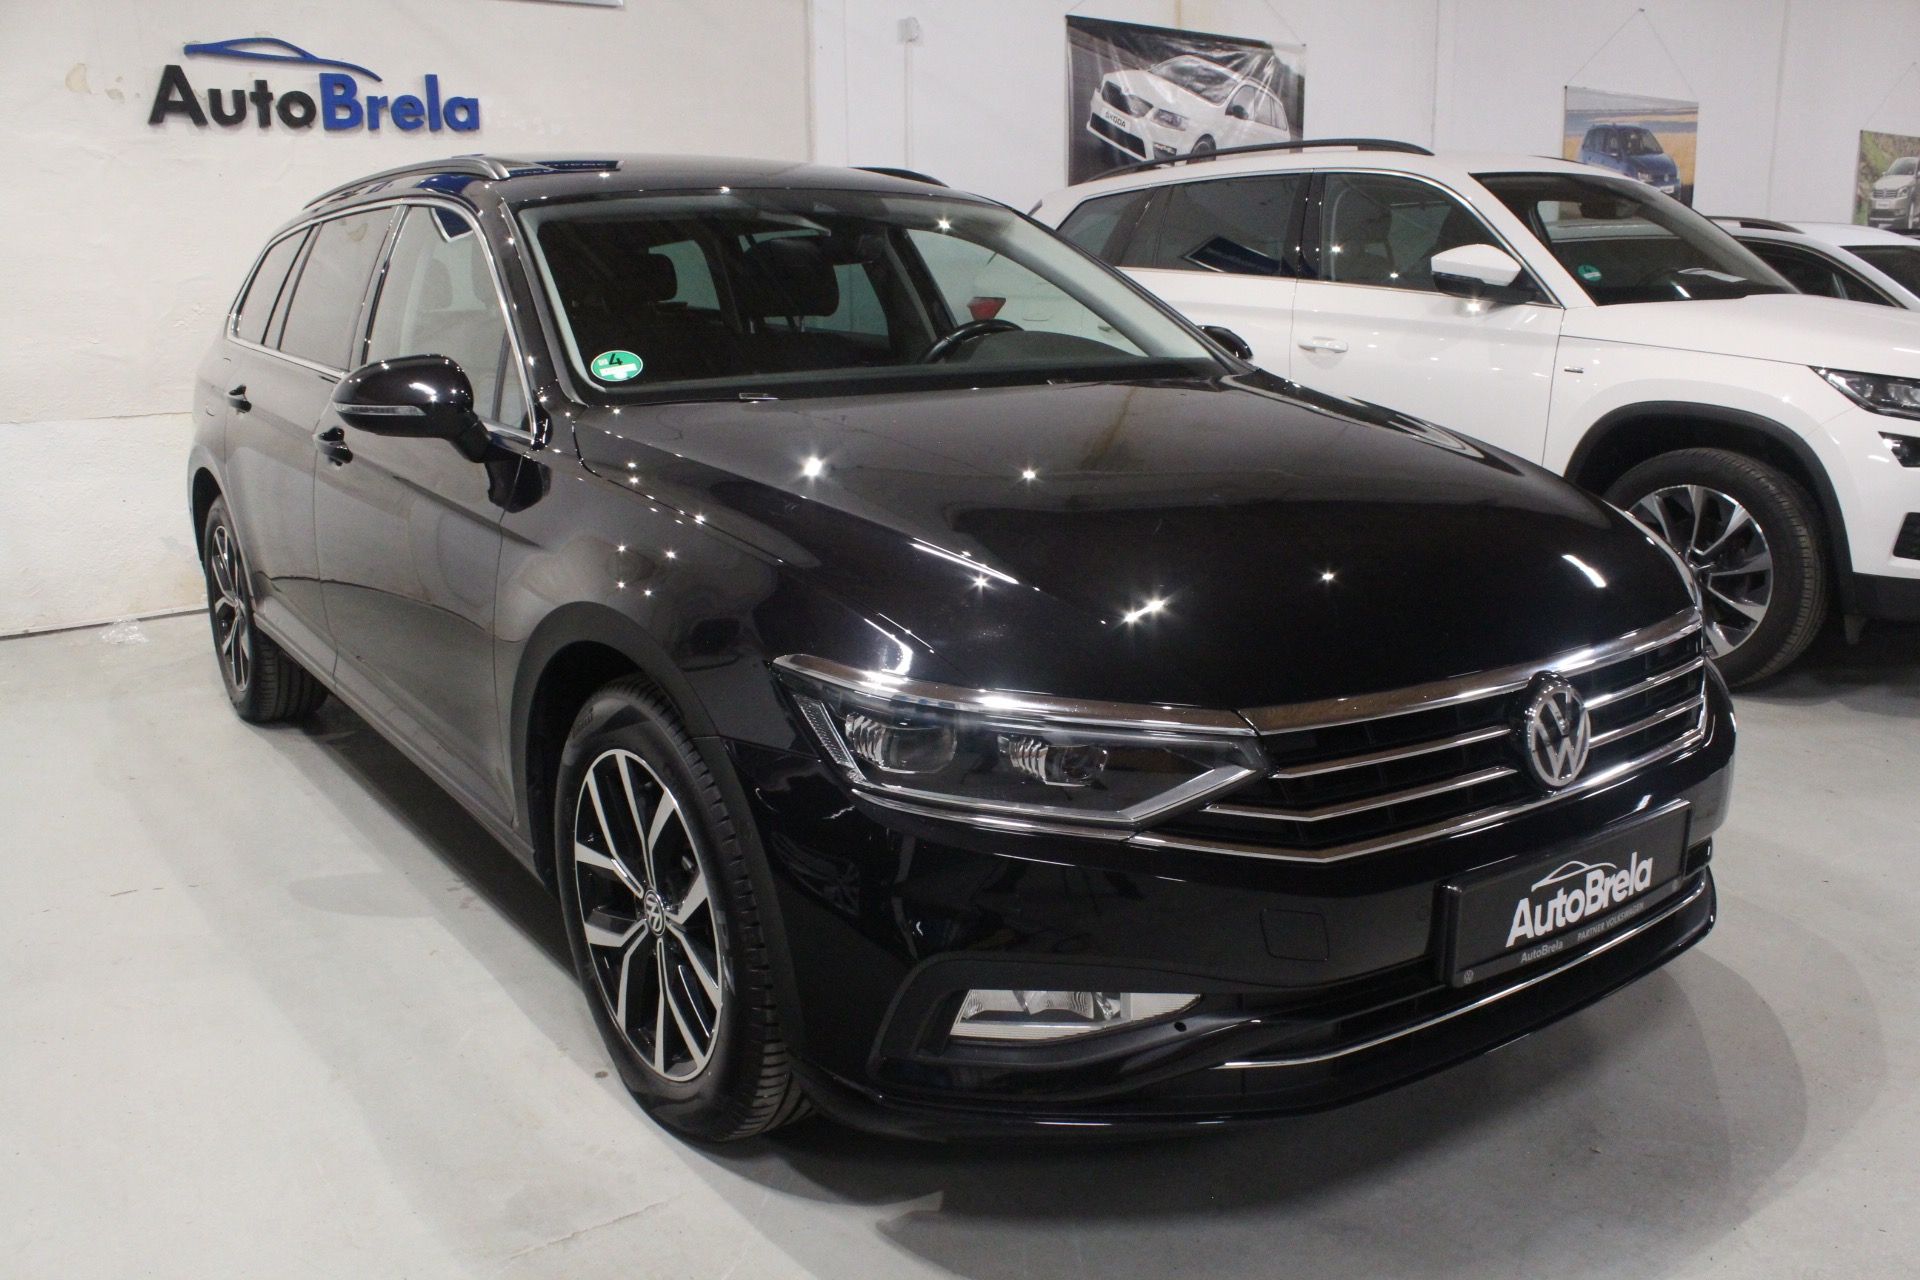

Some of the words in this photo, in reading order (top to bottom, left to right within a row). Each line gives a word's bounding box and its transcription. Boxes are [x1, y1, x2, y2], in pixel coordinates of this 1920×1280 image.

[148, 65, 479, 131] AutoBrela
[609, 353, 623, 365] 4
[1505, 851, 1653, 948] AutoBrela
[1520, 939, 1564, 964] AutoBrela
[1577, 923, 1605, 942] PARTNER
